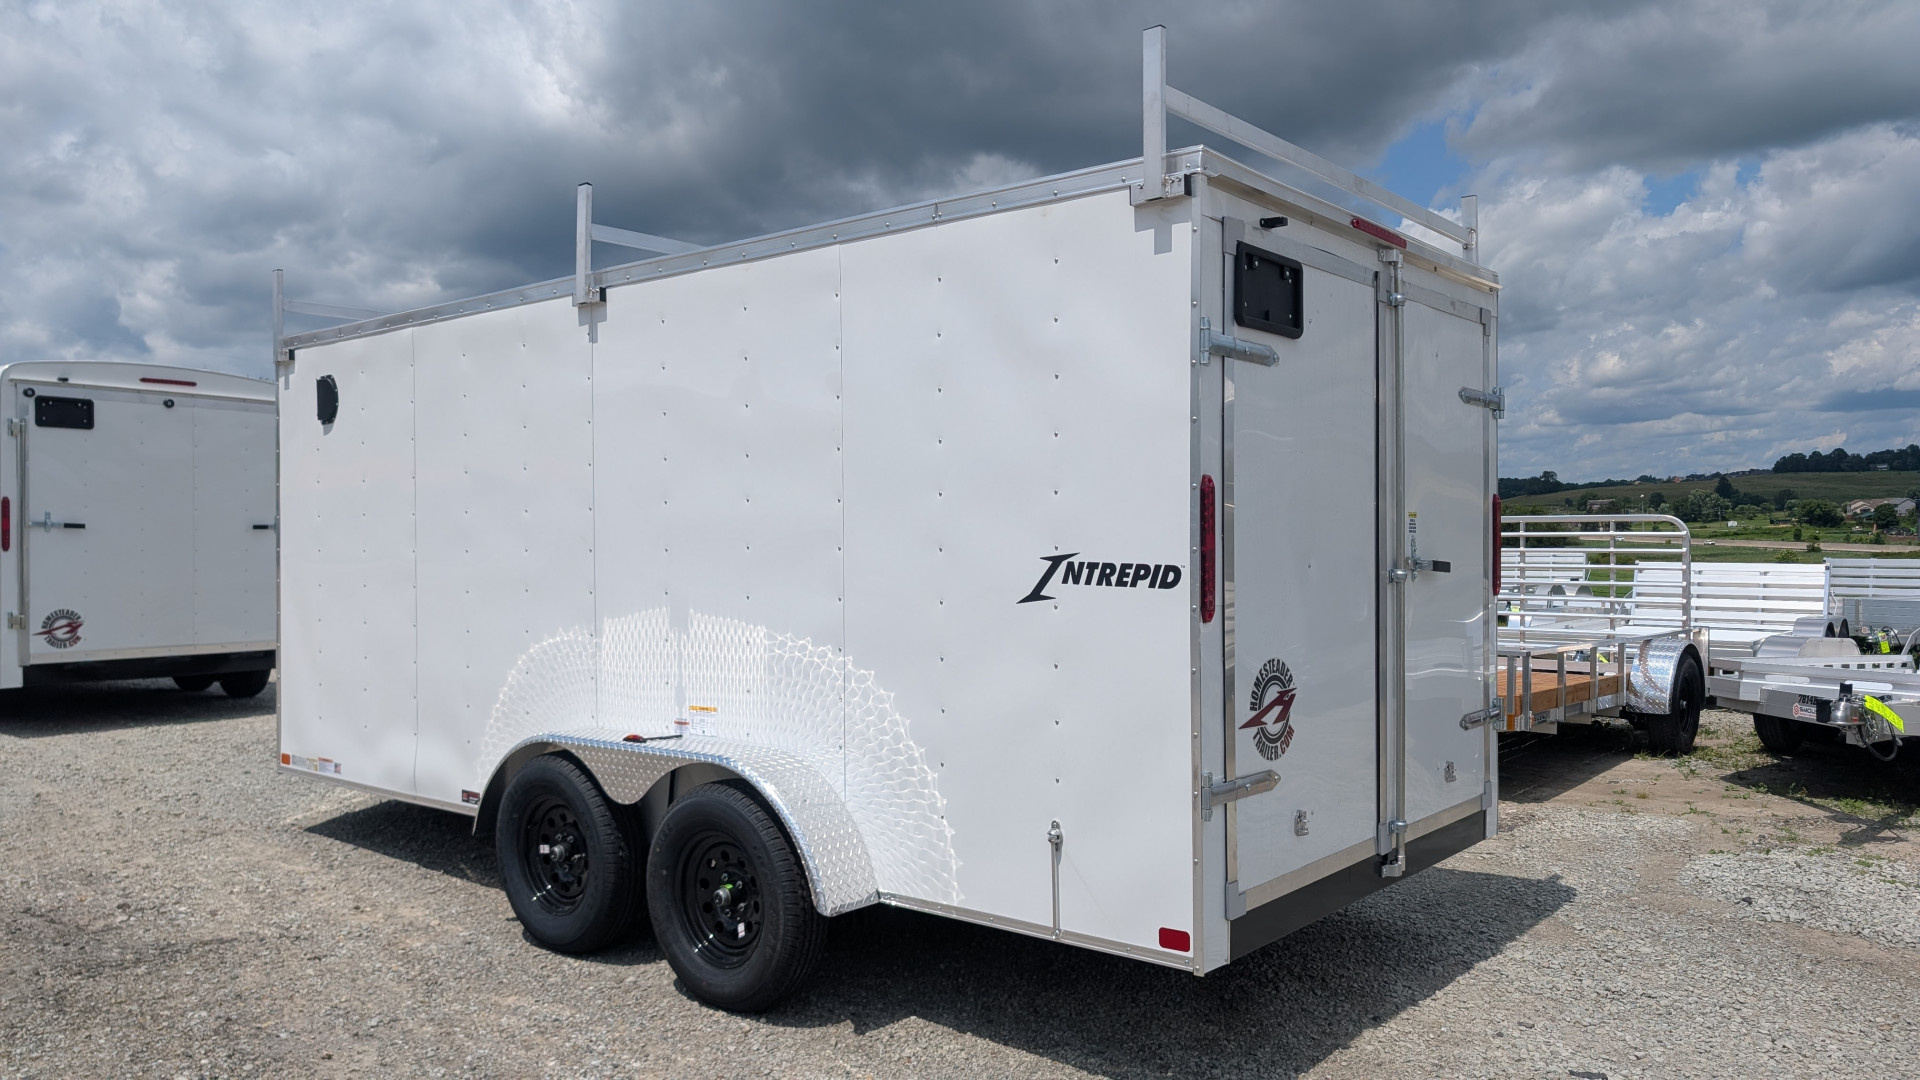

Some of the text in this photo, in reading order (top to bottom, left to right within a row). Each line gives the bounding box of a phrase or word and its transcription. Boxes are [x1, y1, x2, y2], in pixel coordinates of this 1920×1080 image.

[1016, 552, 1182, 604] INTREPID
[1249, 658, 1294, 712] HOMESTEADER
[1252, 724, 1295, 761] TRAILER.COM
